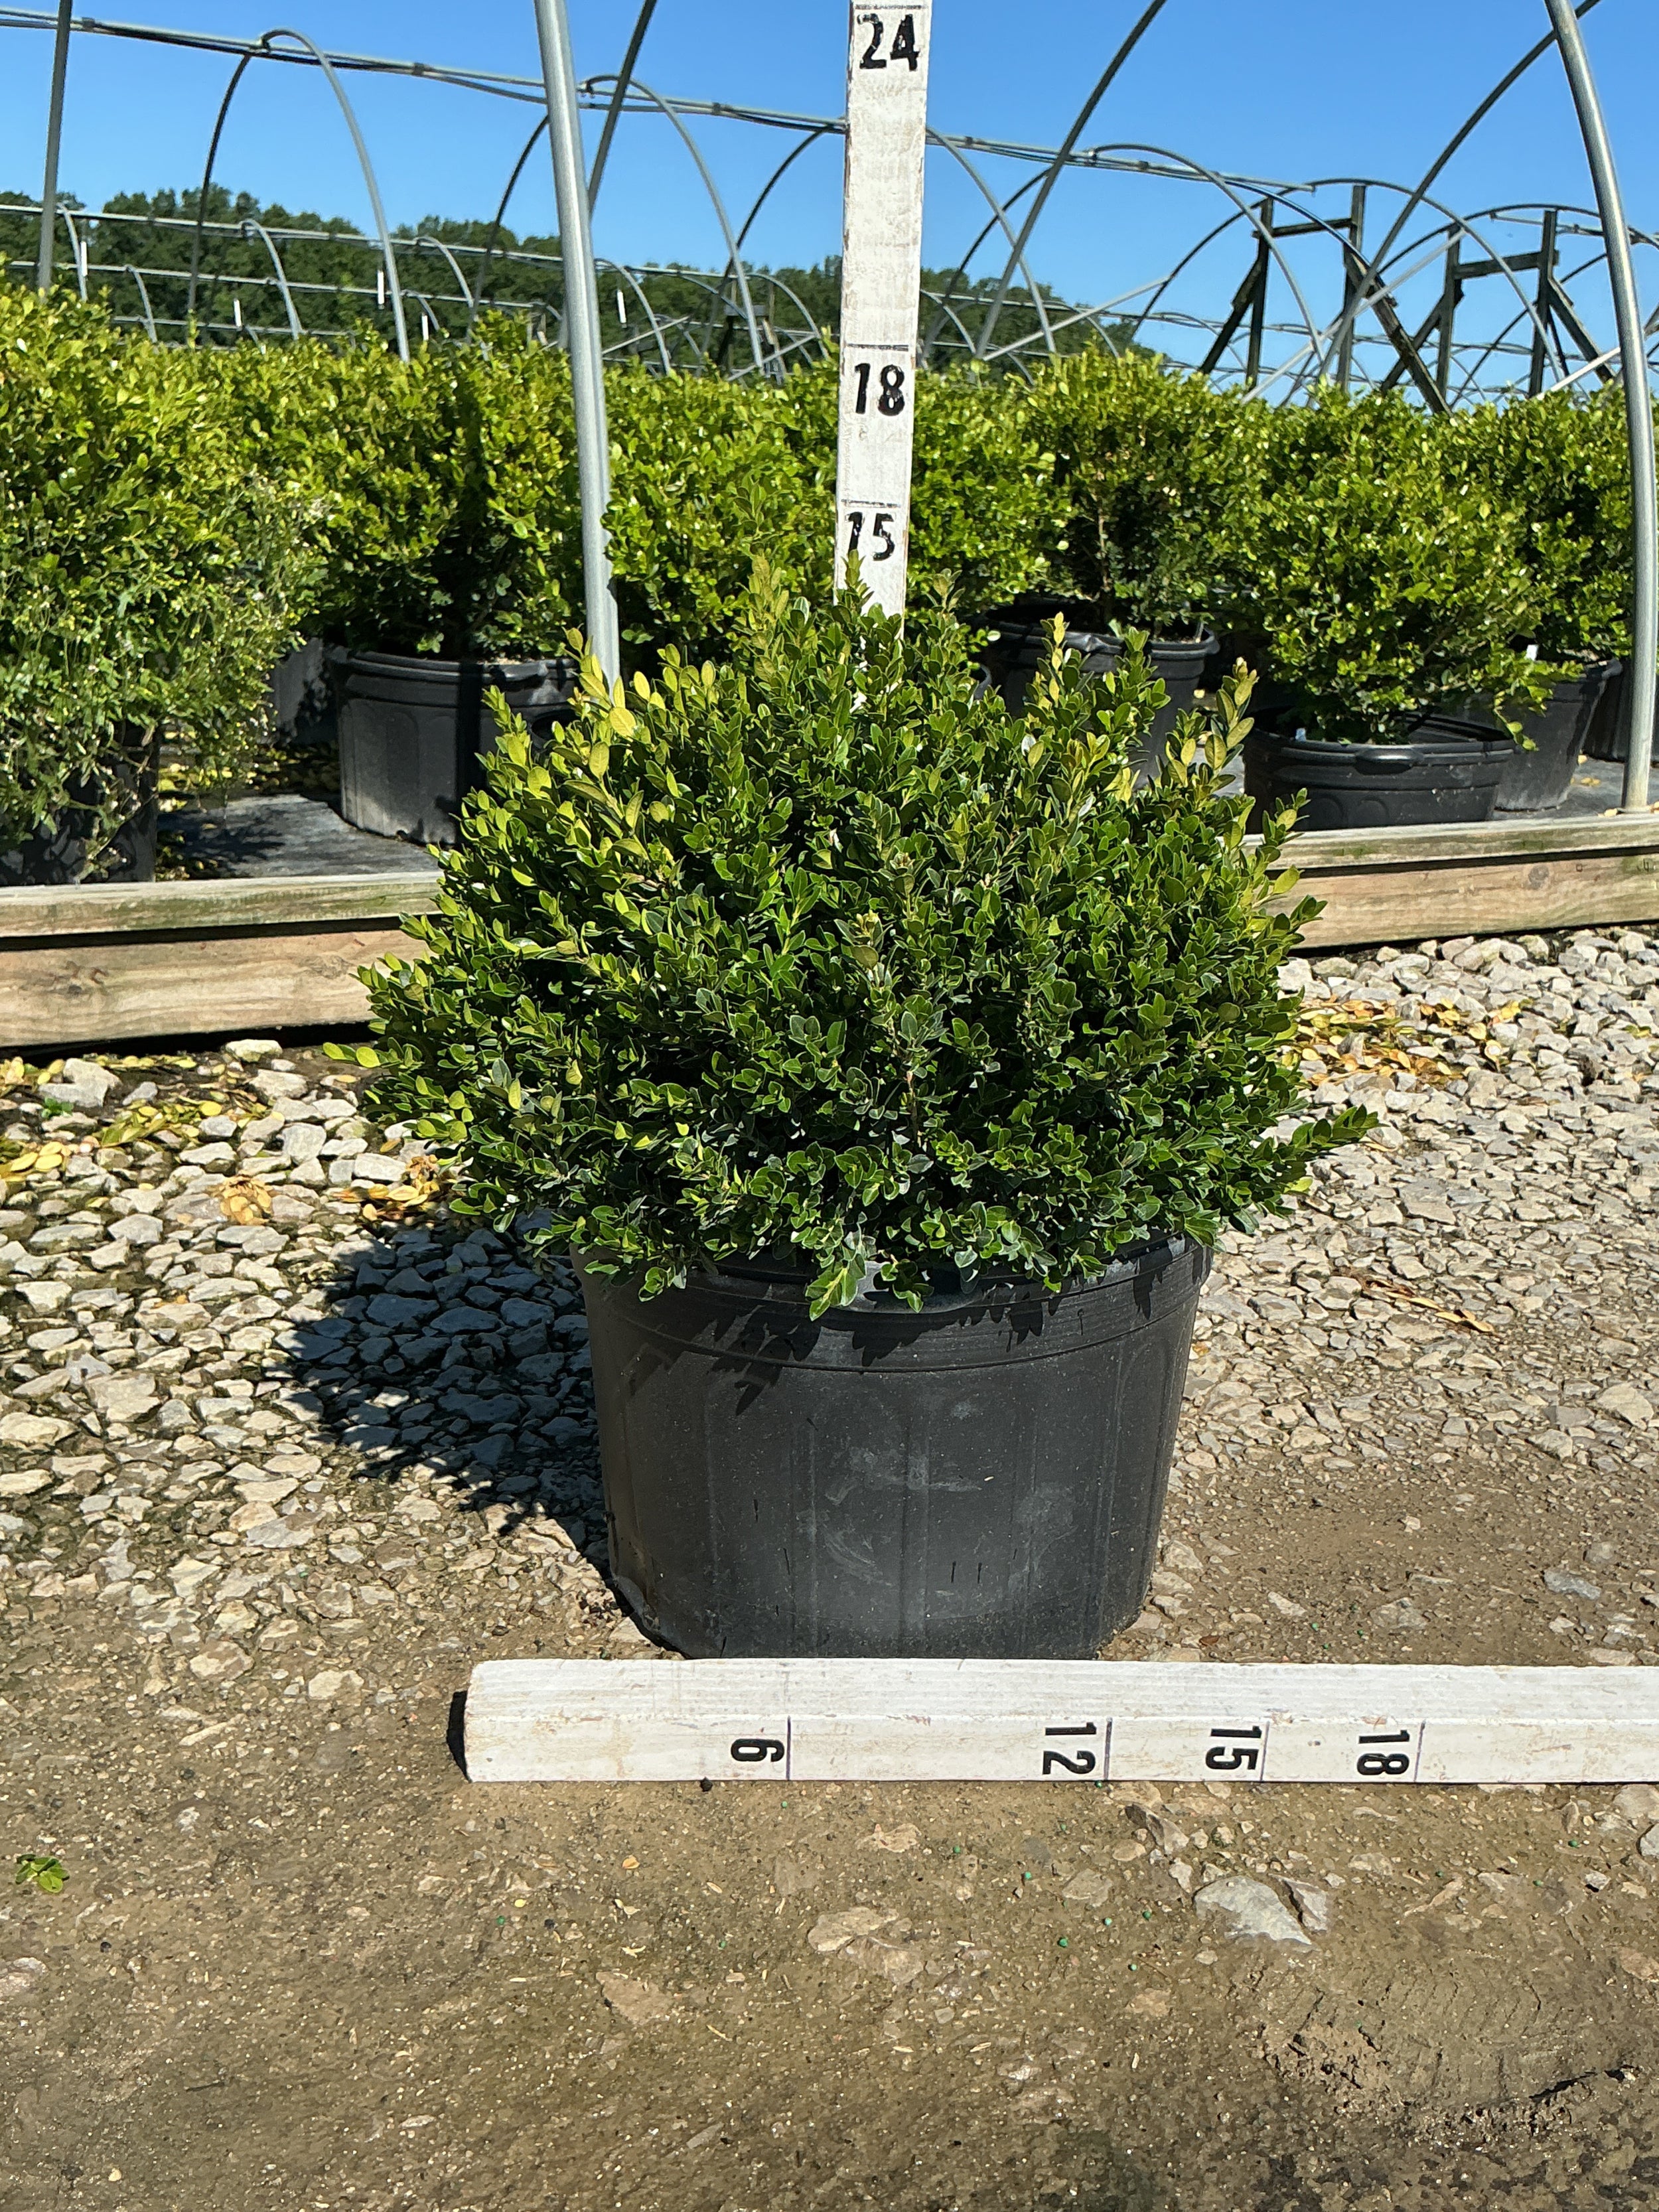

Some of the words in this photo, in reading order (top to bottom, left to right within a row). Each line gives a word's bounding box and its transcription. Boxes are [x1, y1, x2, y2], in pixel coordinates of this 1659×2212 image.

[857, 13, 920, 71] 24
[854, 362, 905, 416] 18
[845, 512, 895, 561] 15
[730, 1738, 785, 1763] 6
[1042, 1722, 1097, 1775] 12
[1205, 1726, 1262, 1770] 15
[1356, 1729, 1410, 1776] 18
